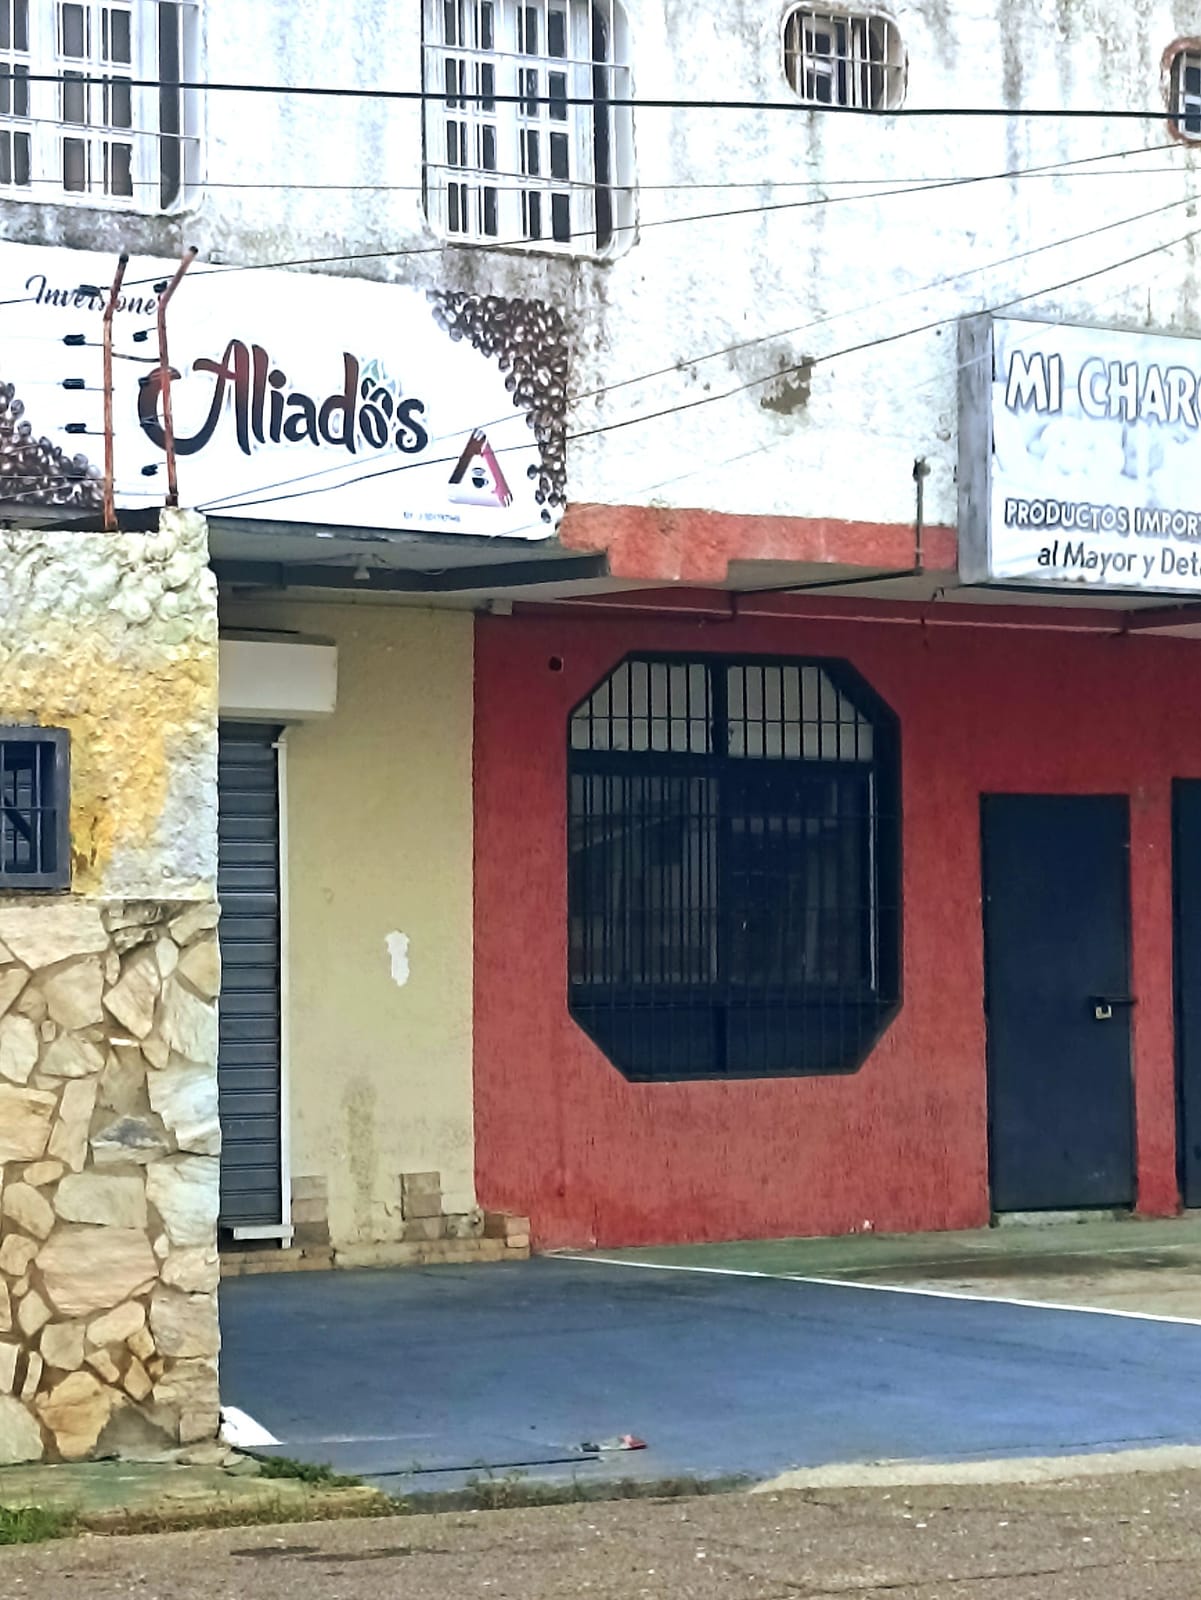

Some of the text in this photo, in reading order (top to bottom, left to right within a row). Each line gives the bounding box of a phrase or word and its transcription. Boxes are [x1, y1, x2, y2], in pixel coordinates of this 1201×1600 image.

[1005, 350, 1201, 429] MI CHAR
[1005, 499, 1201, 543] PRODUCTOS IMPOR
[1037, 540, 1201, 579] al Mayor y Det
